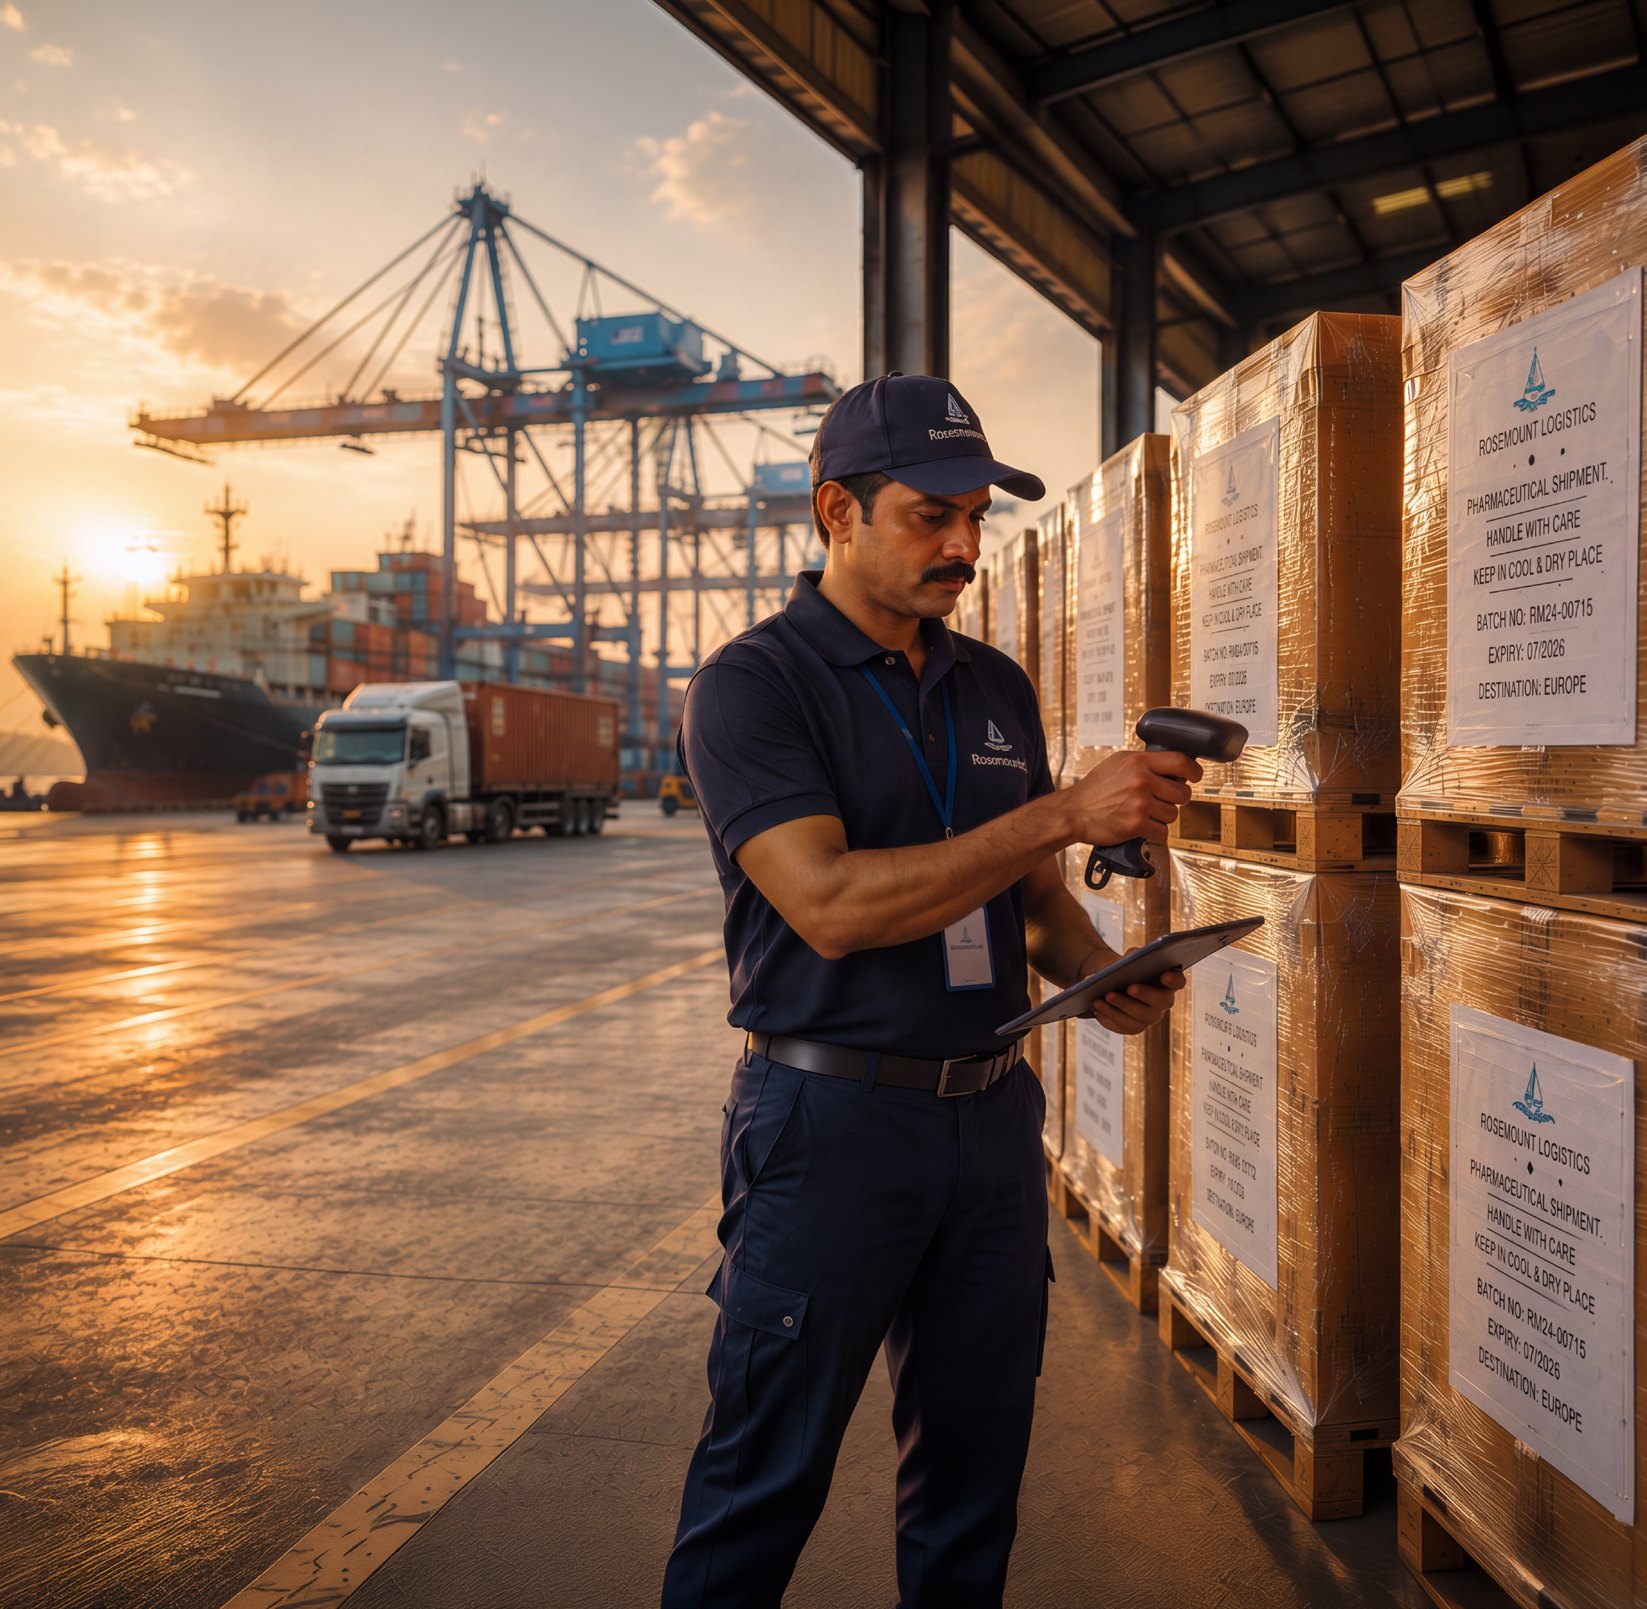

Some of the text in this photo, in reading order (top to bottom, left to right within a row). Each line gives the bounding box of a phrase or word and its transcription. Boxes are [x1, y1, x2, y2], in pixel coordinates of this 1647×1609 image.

[1479, 402, 1596, 456] ROSEMOUNT LOGISTICS
[1467, 479, 1549, 516] PHARMACEUTICAL
[1486, 510, 1580, 547] HANDLE WITH CARE
[1474, 544, 1603, 586] KEEP IN COOL & DRY PLACE
[1476, 598, 1593, 631] BATCH NO: RM24-00715
[1488, 638, 1565, 664] EXPIRY: 07/2026
[1478, 674, 1586, 700] DESTINATION: EUROPE
[1480, 1112, 1590, 1175] ROSEMOUNT LOGISTICS
[1470, 1158, 1548, 1213] PHARMACEUTICAL
[1487, 1203, 1576, 1266] HANDLE WITH CARE
[1474, 1233, 1595, 1316] KEEP IN COOL & DRY PLACE
[1477, 1278, 1586, 1360] BATCH NO: RM24-00715
[1488, 1316, 1560, 1380] EXPIRY: 07/2026
[1478, 1346, 1583, 1434] DESTINATION: EUROPE
